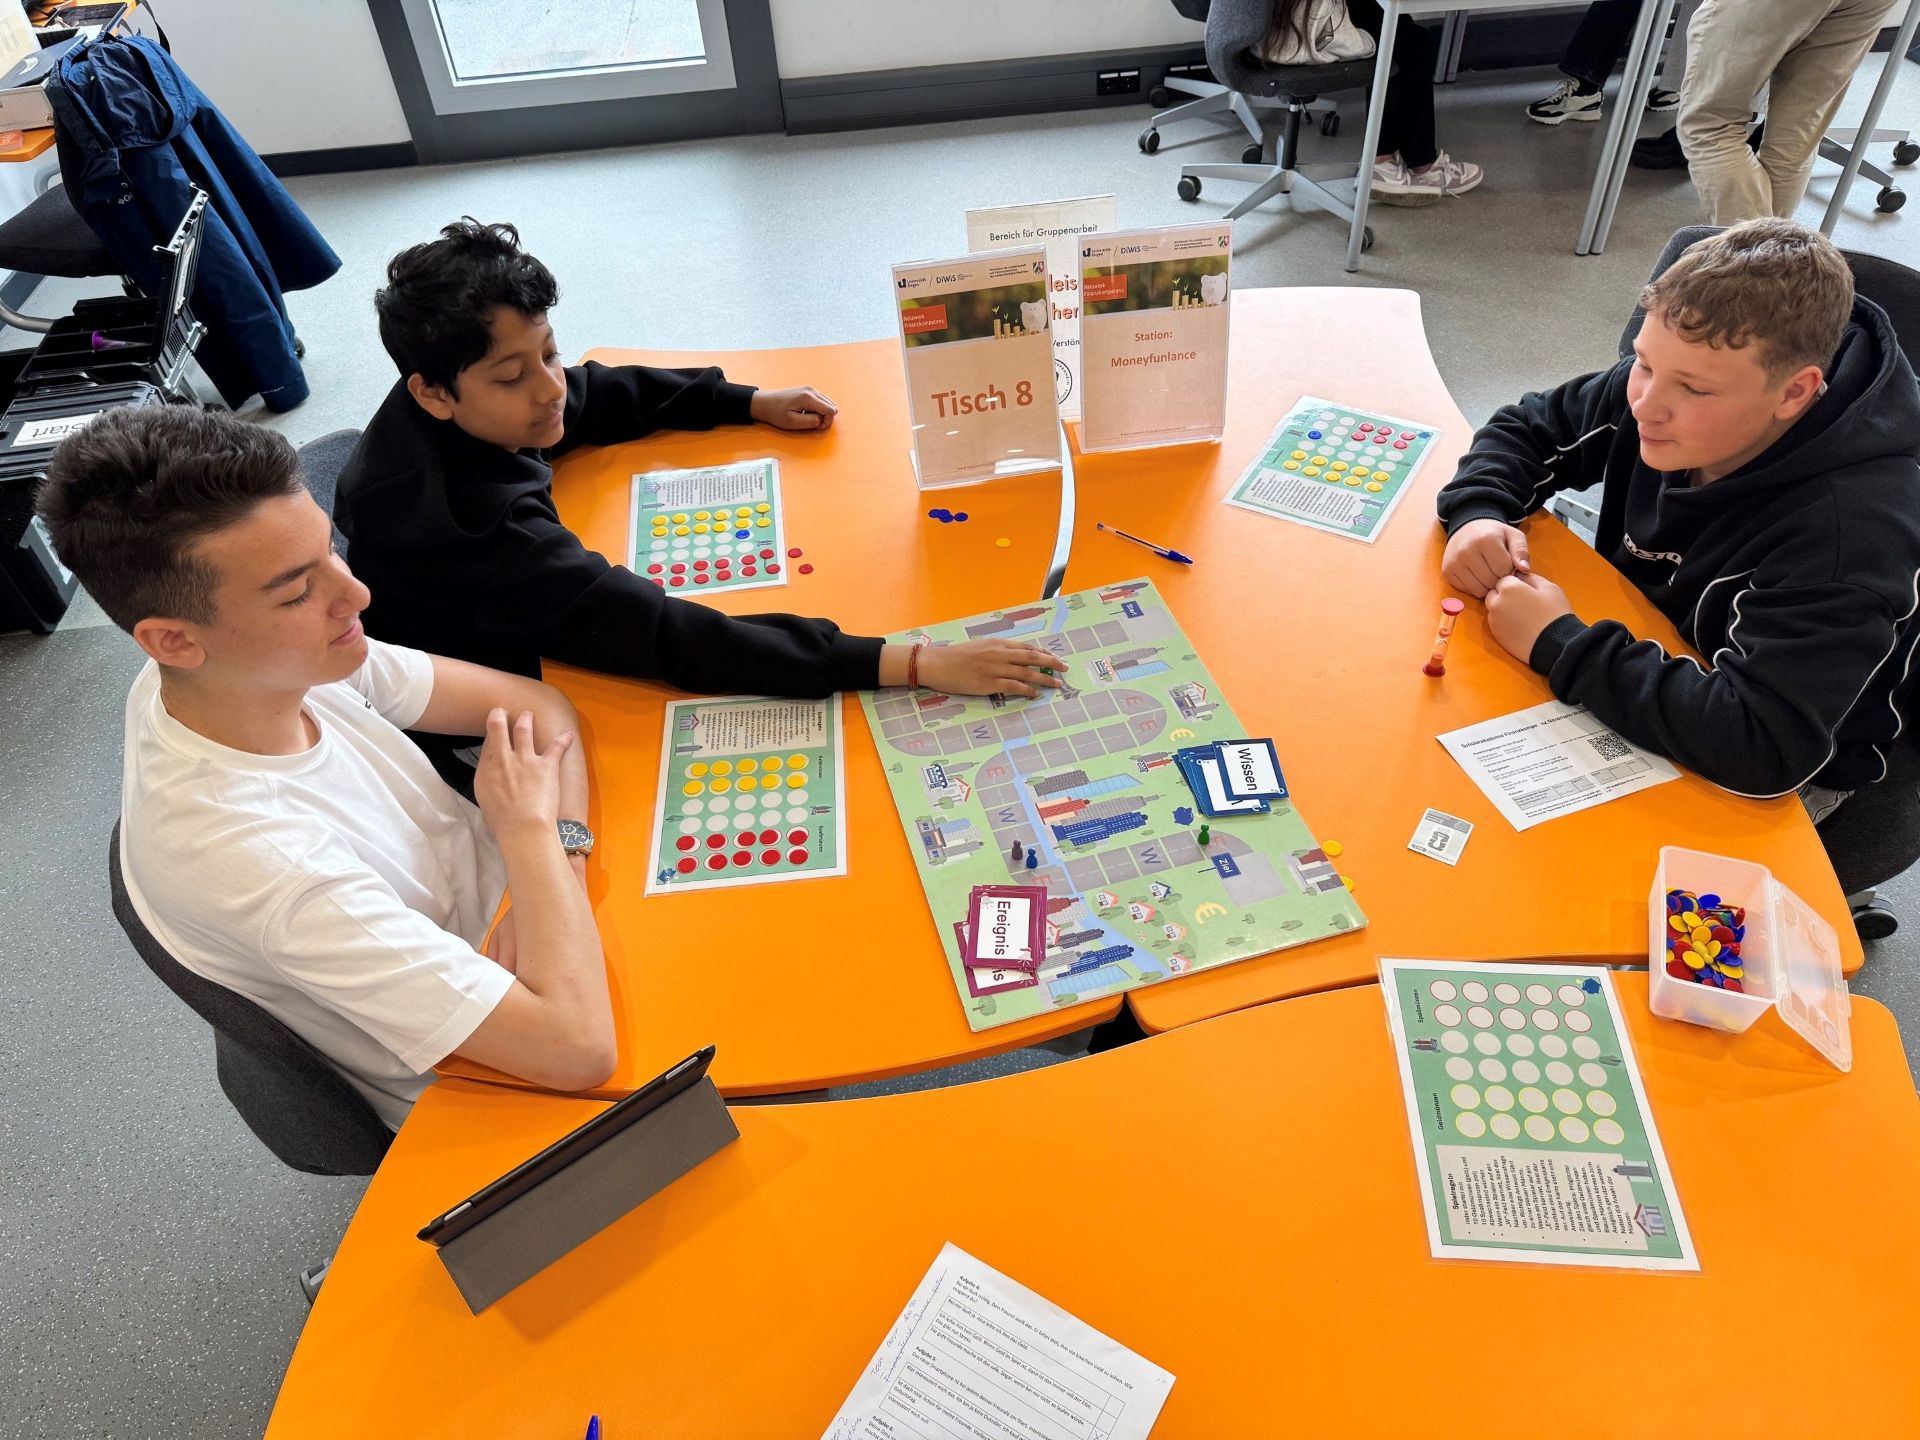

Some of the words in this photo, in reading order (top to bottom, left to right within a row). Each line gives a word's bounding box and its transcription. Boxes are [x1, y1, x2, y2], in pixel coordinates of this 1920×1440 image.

[990, 229, 1020, 241] Bereich
[1022, 228, 1034, 238] für
[1036, 224, 1098, 240] Gruppenarbeit
[904, 319, 944, 328] Finanzkompetenz
[1134, 330, 1173, 342] Station:
[1111, 351, 1197, 367] Moneyfunlance
[931, 384, 1007, 418] Tisch
[1016, 380, 1034, 406] 8
[1237, 748, 1258, 790] Wissen
[1218, 858, 1234, 873] Ziel
[992, 901, 1011, 956] Ereignis
